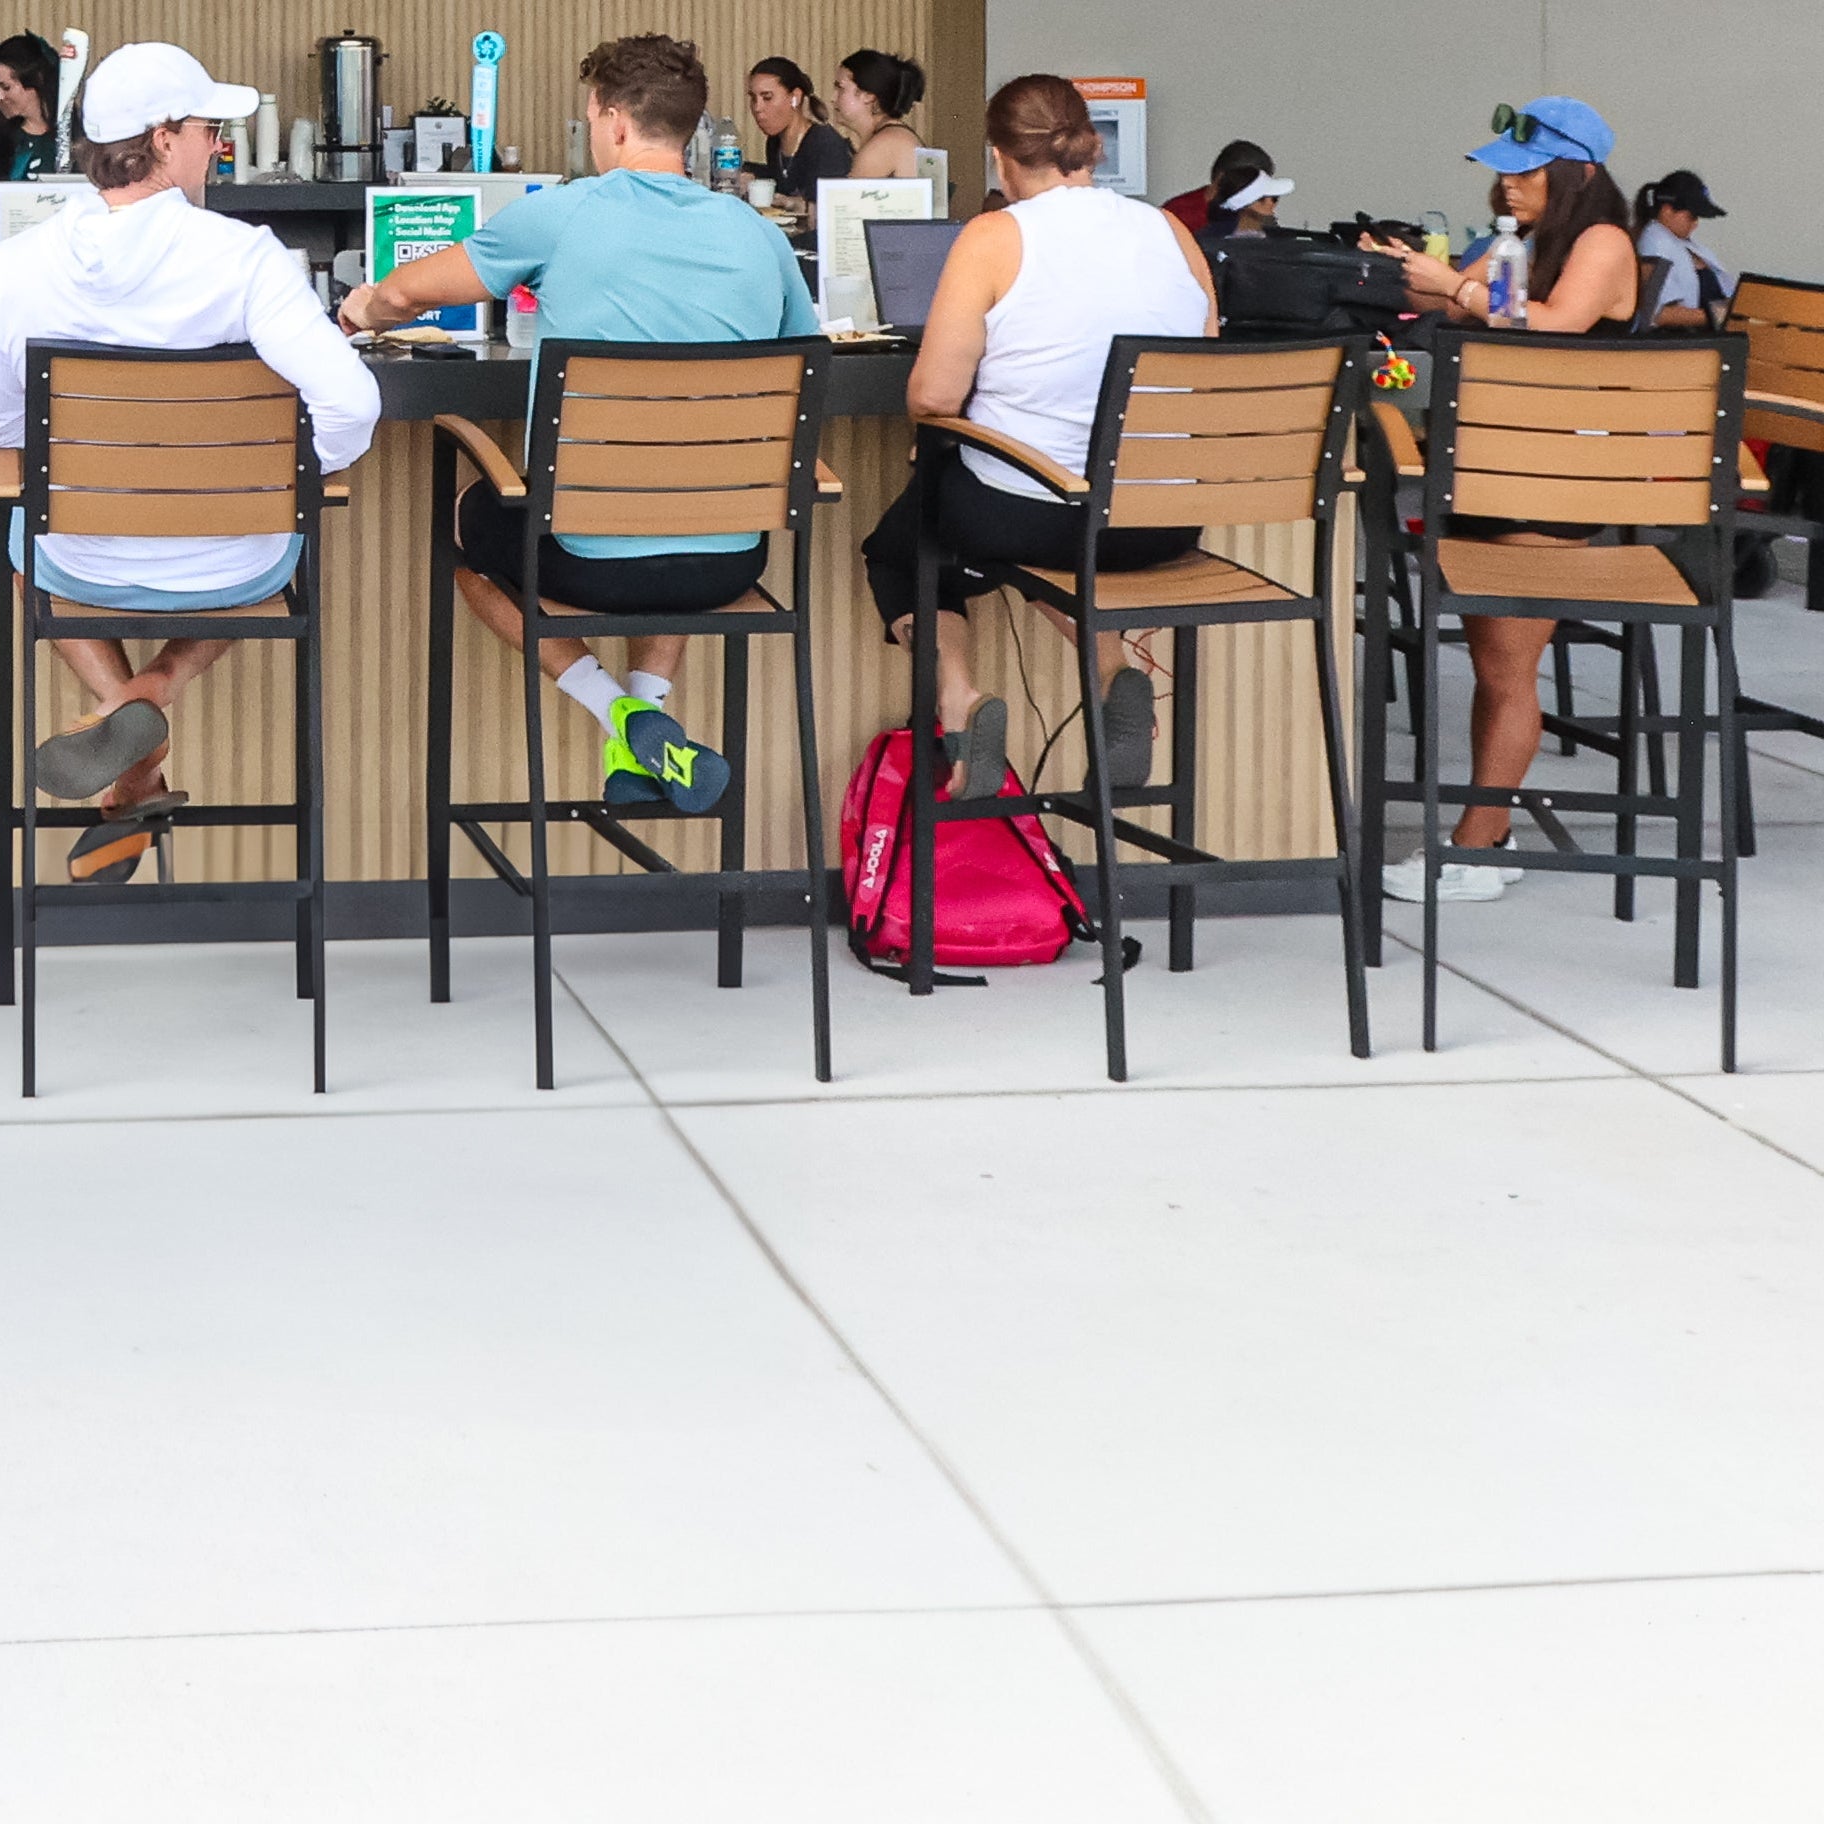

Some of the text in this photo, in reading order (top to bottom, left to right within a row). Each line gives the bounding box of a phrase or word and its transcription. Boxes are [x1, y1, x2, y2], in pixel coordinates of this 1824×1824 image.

[394, 203, 461, 214] Download App
[394, 216, 455, 226] Location Map
[395, 227, 451, 236] Social Media
[416, 310, 442, 321] ORT
